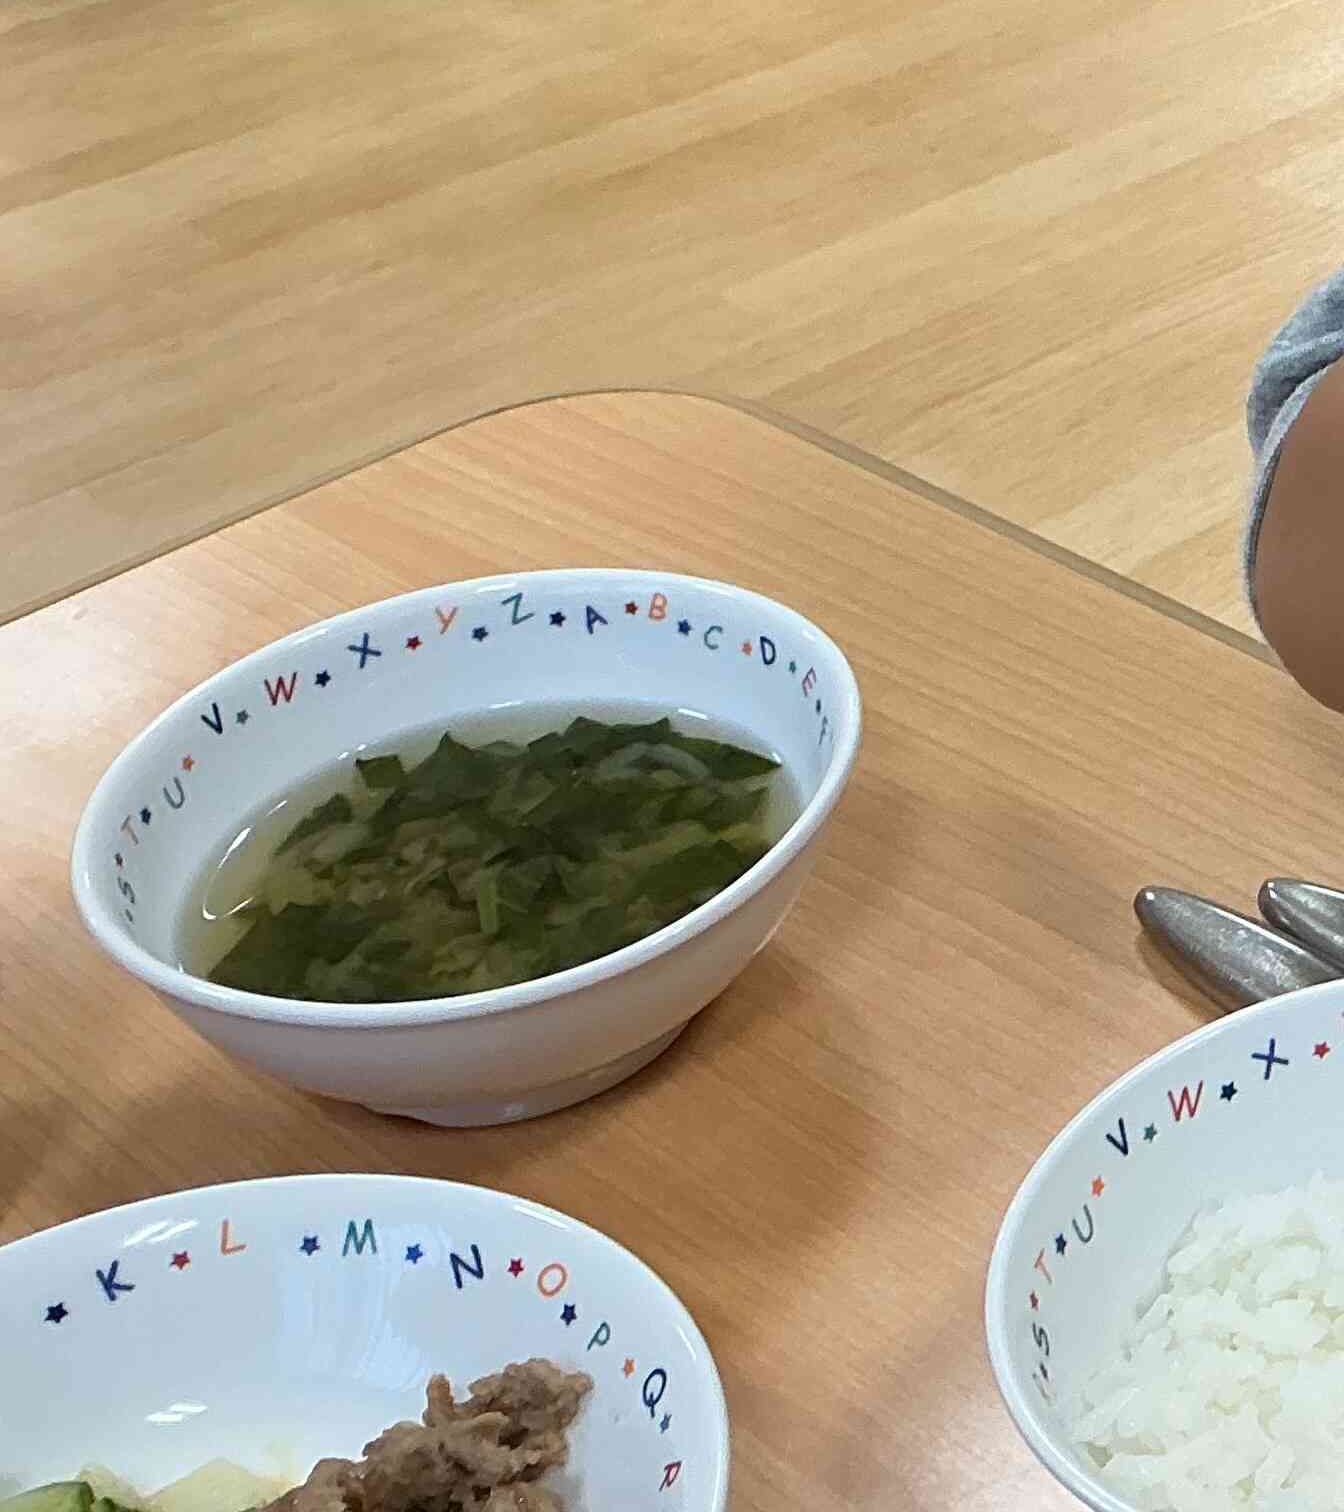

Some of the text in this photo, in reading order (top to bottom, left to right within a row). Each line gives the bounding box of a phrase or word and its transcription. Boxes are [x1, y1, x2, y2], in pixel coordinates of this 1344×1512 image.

[121, 815, 139, 845] T
[163, 777, 186, 809] U
[200, 702, 223, 734] V
[264, 672, 297, 706] W
[347, 632, 382, 669] X
[435, 606, 459, 635] Y
[501, 592, 534, 625] Z
[585, 605, 608, 634] A
[648, 592, 668, 621] B
[703, 625, 723, 650] C
[759, 636, 776, 665] D
[802, 667, 817, 696] E
[1252, 1038, 1289, 1080] X
[1168, 1081, 1203, 1121] W
[1106, 1118, 1128, 1156] V
[1072, 1204, 1094, 1243] U
[1034, 1248, 1052, 1285] T
[96, 1260, 135, 1301] K
[221, 1219, 247, 1255] L
[342, 1219, 377, 1256] M
[450, 1244, 484, 1289] N
[537, 1263, 567, 1298] O
[587, 1322, 611, 1351] P
[642, 1368, 667, 1418] Q
[1032, 1322, 1050, 1356] S
